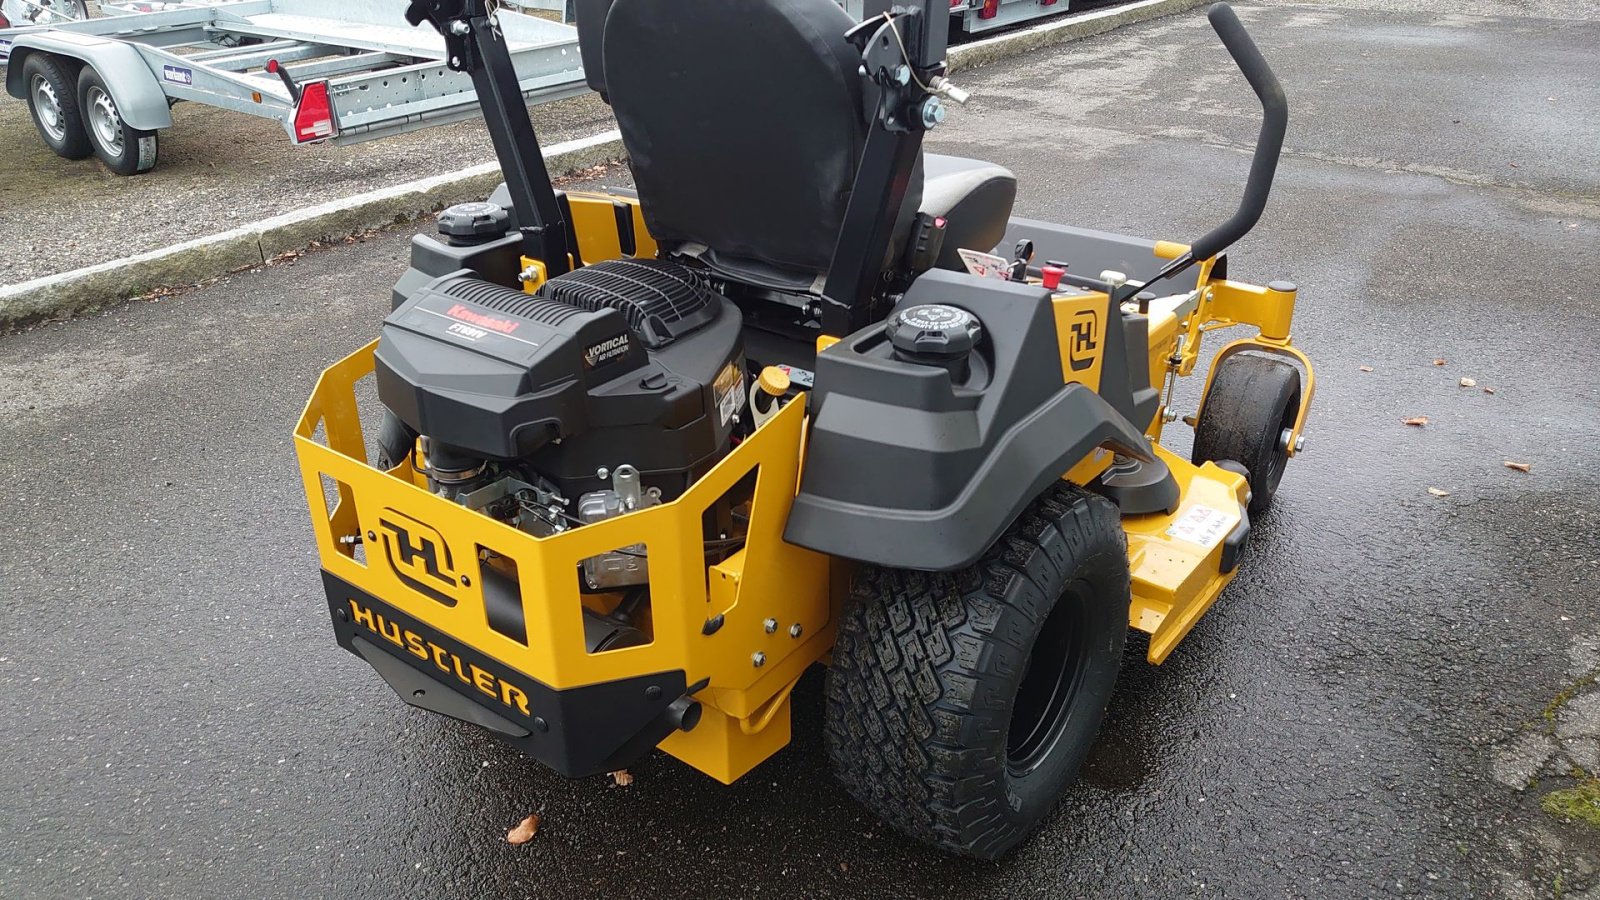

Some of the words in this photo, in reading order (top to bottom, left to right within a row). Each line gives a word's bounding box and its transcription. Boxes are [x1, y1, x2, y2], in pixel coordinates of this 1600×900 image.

[447, 304, 520, 334] Kawasaki
[588, 334, 629, 357] VORTICAL
[598, 352, 606, 362] AIR
[606, 345, 629, 359] FILTRATION
[349, 600, 530, 715] HUSTLER
